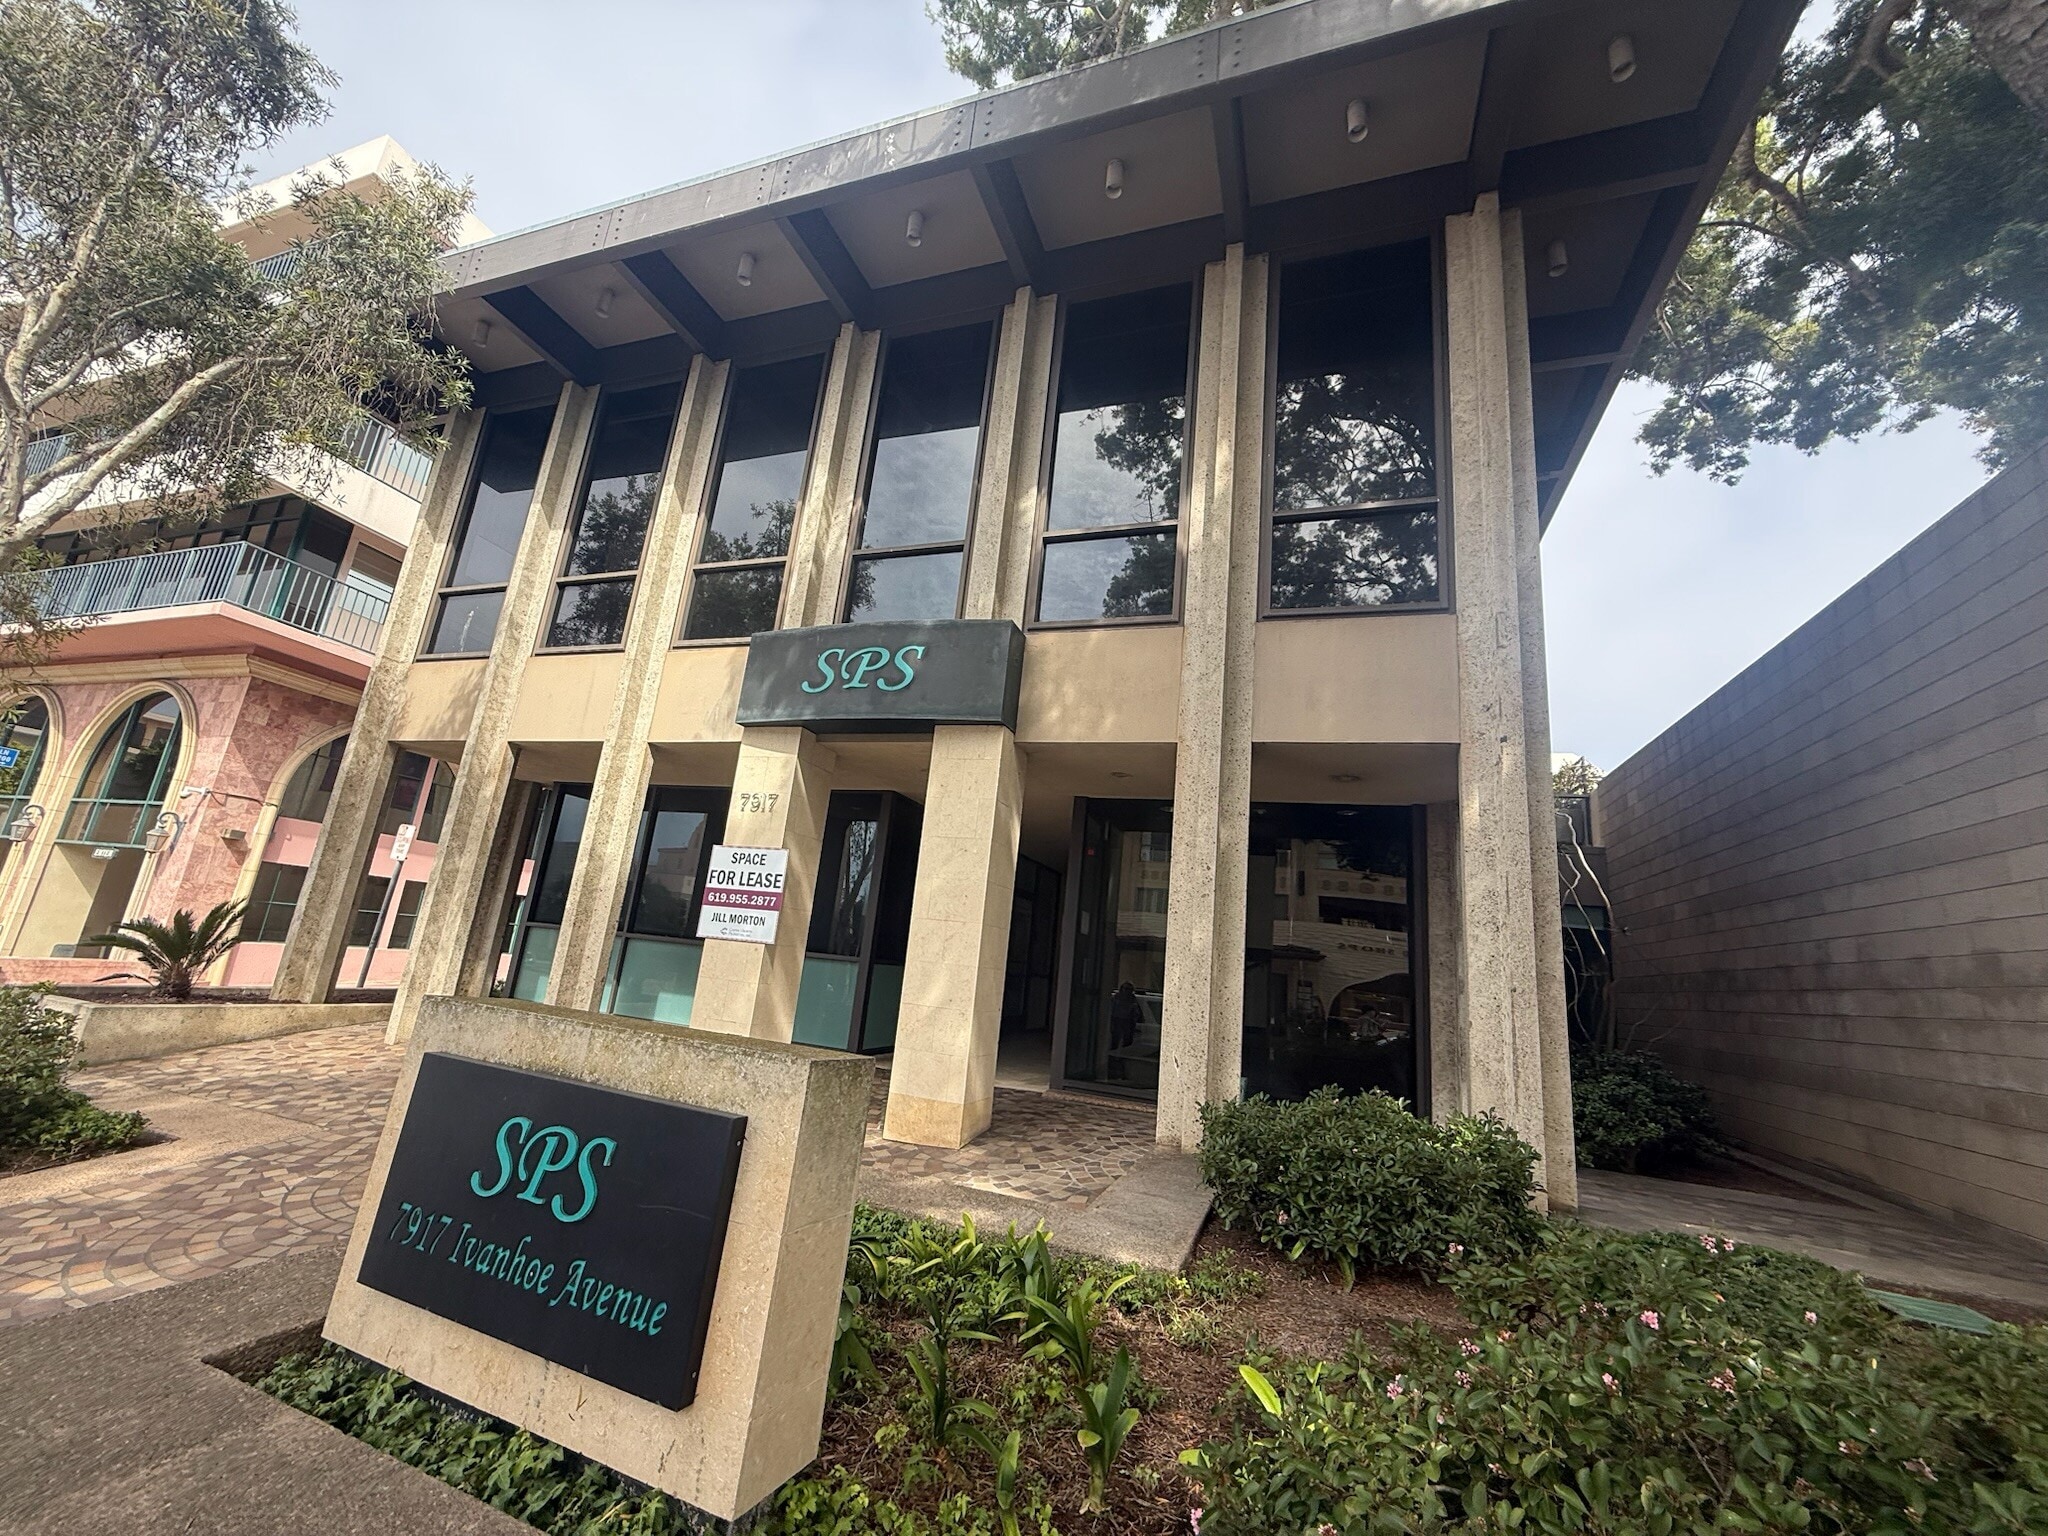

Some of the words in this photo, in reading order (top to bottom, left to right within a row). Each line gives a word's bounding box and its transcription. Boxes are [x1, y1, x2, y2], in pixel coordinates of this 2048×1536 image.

[801, 645, 925, 693] SPS
[740, 793, 779, 813] 7917
[731, 852, 768, 866] SPACE
[708, 869, 735, 886] FOR
[738, 870, 783, 889] LEASE
[707, 892, 777, 907] 619.955.2877
[711, 912, 727, 923] JILL
[728, 913, 766, 927] MORTON
[470, 1116, 617, 1223] SPS
[388, 1202, 455, 1253] 7917
[447, 1222, 555, 1295] Ivanhoe
[549, 1260, 669, 1336] Avenue
